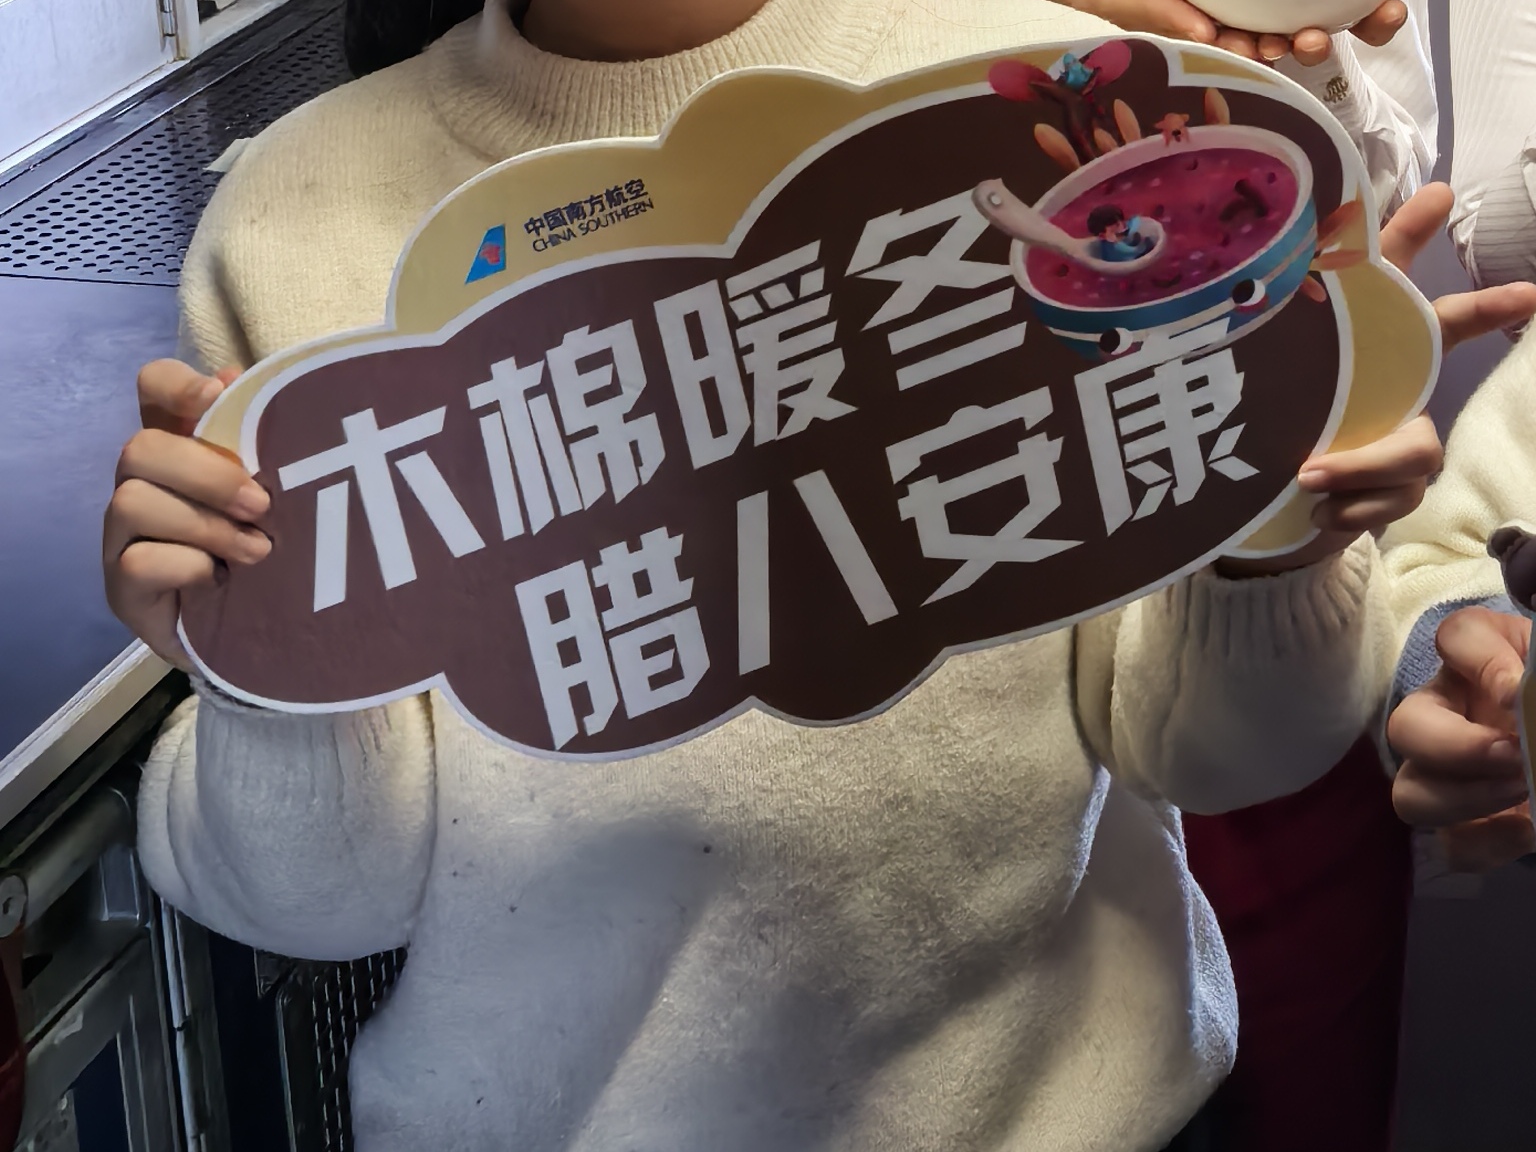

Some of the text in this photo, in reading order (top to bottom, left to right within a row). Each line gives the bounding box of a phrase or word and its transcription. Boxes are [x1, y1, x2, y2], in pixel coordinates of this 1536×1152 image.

[523, 179, 649, 236] 中国南方航空
[532, 199, 654, 252] CHINA SOUTHERN
[277, 188, 1028, 613] 木棉暖冬
[514, 317, 1261, 750] 腊八安康
